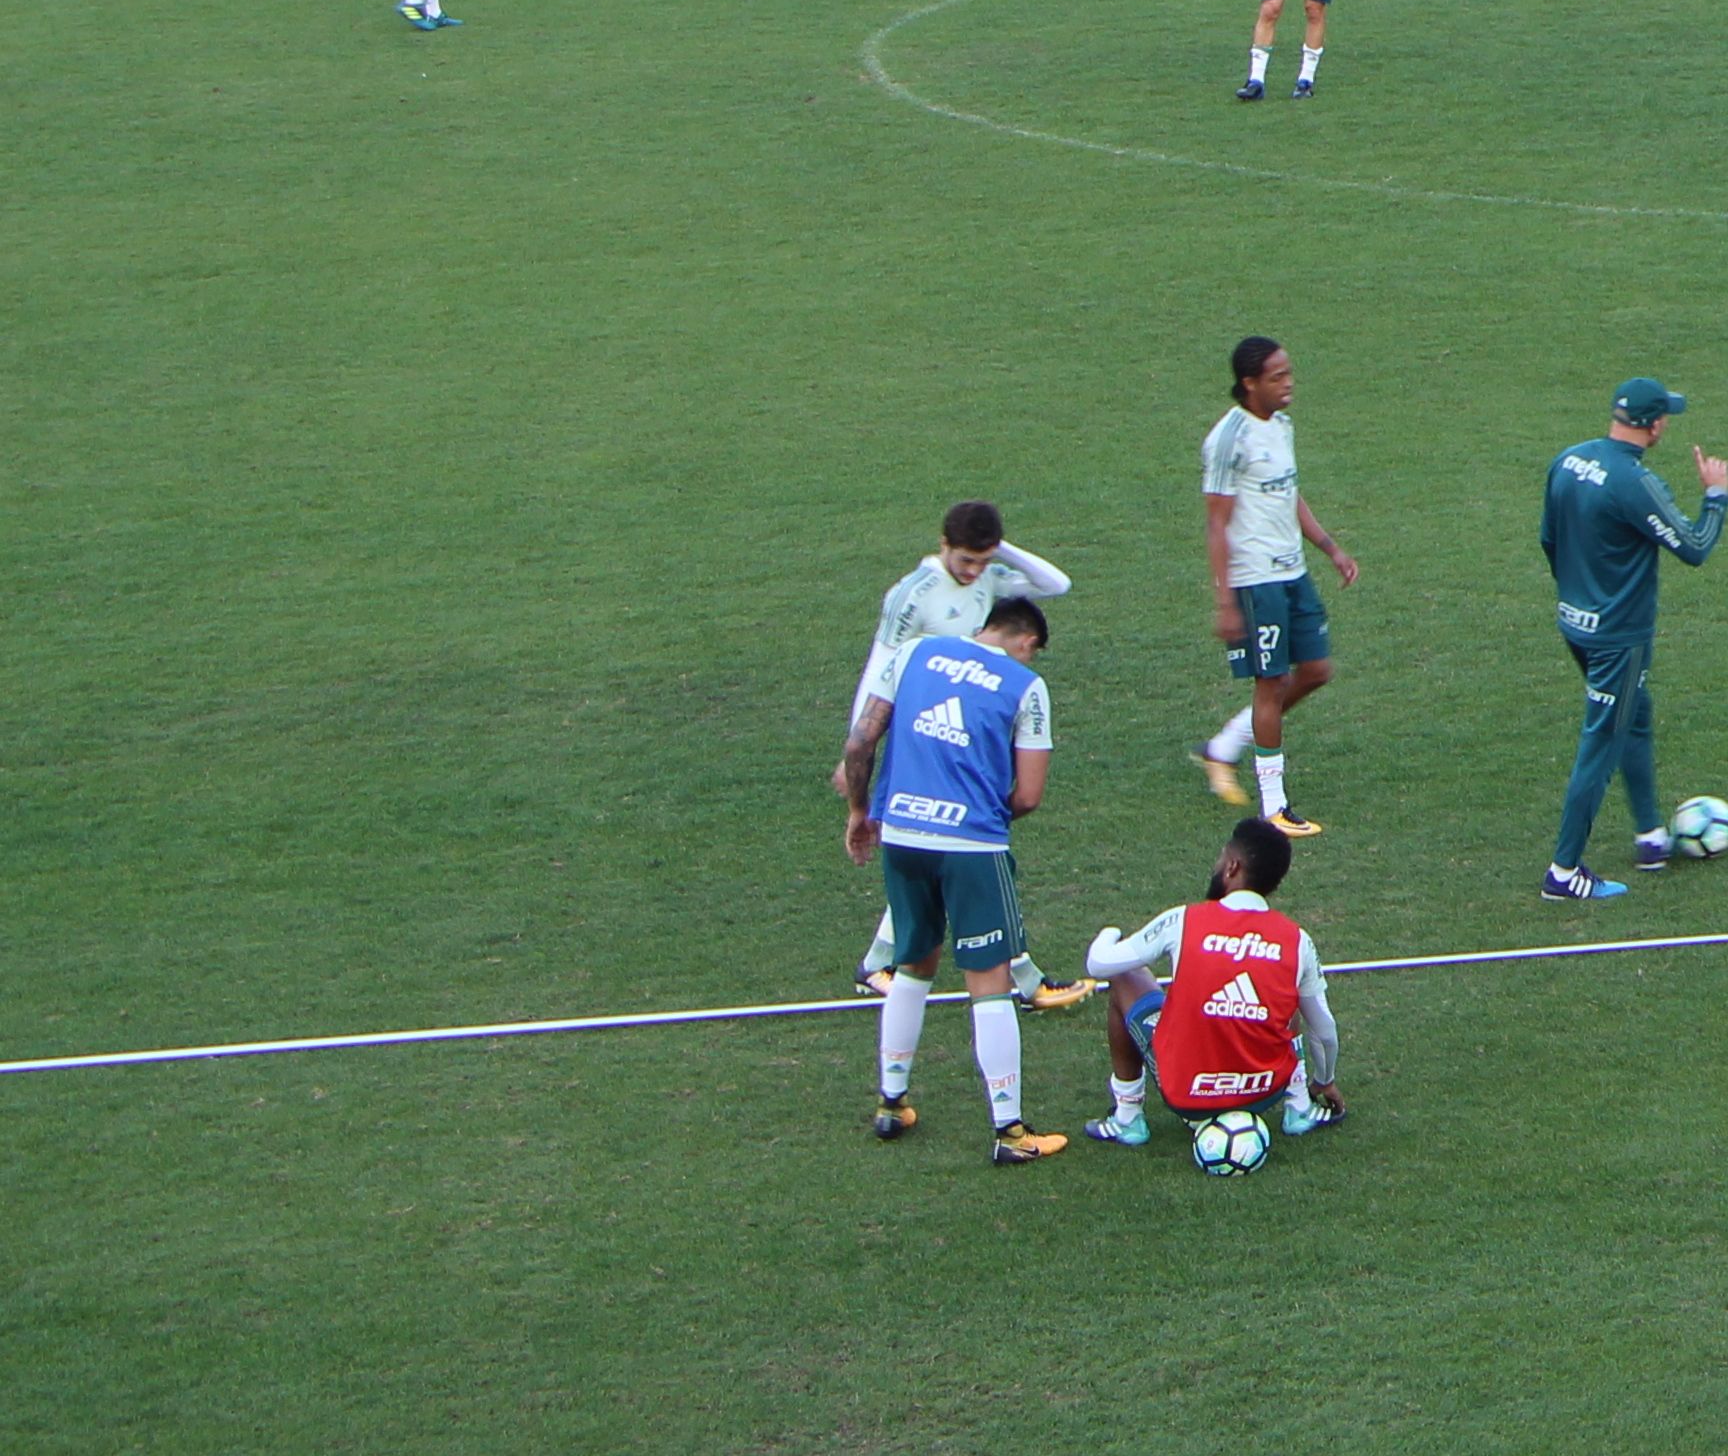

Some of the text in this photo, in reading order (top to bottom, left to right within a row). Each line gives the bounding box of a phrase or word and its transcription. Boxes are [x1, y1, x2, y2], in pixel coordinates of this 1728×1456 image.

[1258, 625, 1280, 650] 27
[926, 654, 1003, 691] crefisa
[913, 718, 970, 747] adidas
[1203, 932, 1281, 961] crefisa
[1203, 998, 1268, 1021] adidas
